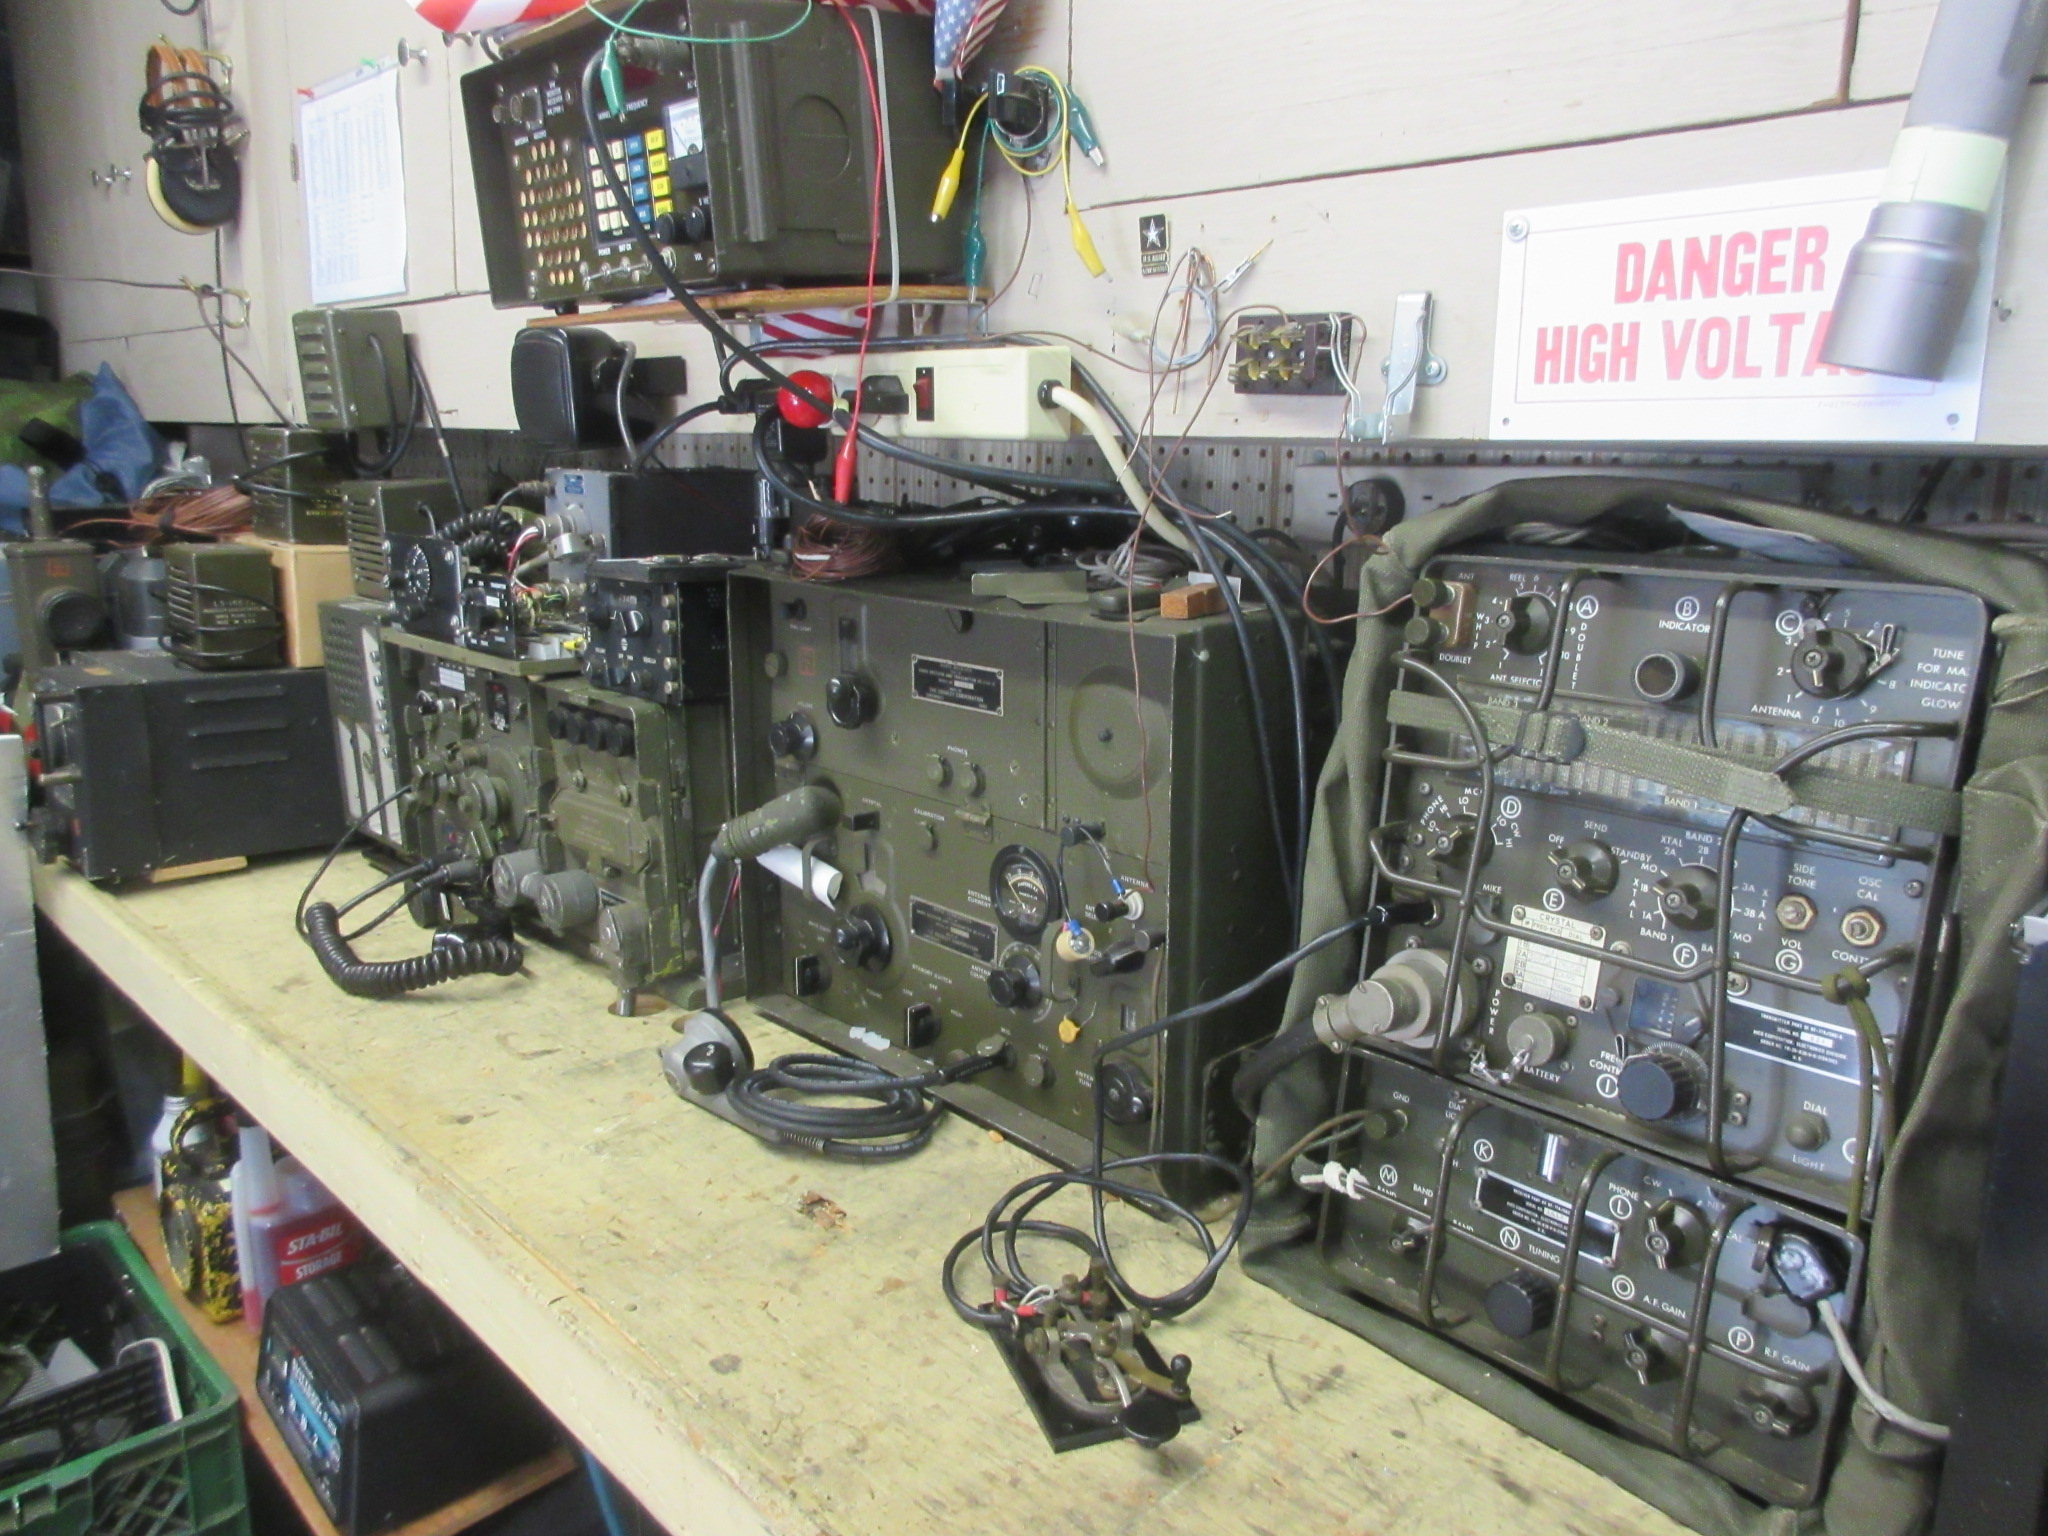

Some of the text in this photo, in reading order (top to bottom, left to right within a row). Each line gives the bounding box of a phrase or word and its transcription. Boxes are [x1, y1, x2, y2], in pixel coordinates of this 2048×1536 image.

[1614, 225, 1830, 304] DANGER
[1533, 311, 1865, 385] HIGH VOLTA
[1510, 574, 1526, 583] REEL
[1534, 575, 1539, 583] 6
[1474, 612, 1484, 650] WHIP
[1570, 627, 1575, 635] 9
[1659, 620, 1710, 633] INDICATOR
[1785, 637, 1791, 645] 3
[1439, 654, 1471, 664] DOUBLET
[1561, 651, 1570, 660] 10
[1571, 623, 1586, 689] DOUBLET
[1933, 648, 1964, 659] TUNE
[1777, 667, 1784, 676] 2
[1917, 663, 1969, 676] FOR MA
[1490, 674, 1543, 686] ANT SELECTO
[1889, 680, 1896, 689] 8
[1910, 679, 1967, 694] INDICATO
[1488, 697, 1507, 706] BAND
[1922, 698, 1962, 710] GLOW
[1751, 705, 1801, 719] ANTENNA
[1869, 706, 1877, 714] 9
[1603, 717, 1608, 726] 2
[1459, 797, 1469, 805] LO
[1664, 796, 1688, 808] BAND
[1421, 795, 1444, 825] PHONE
[1440, 805, 1448, 813] HI
[1428, 821, 1436, 832] LO
[1497, 815, 1506, 826] LO
[1584, 820, 1607, 832] SEND
[1511, 823, 1521, 838] CW
[1506, 839, 1513, 847] HI
[1549, 834, 1565, 845] OFF
[1661, 836, 1682, 847] XTAL
[1686, 831, 1712, 843] BAND
[1611, 846, 1652, 864] STANDBY
[1664, 848, 1676, 856] 2A
[1698, 846, 1708, 854] 2B
[1641, 863, 1657, 872] MO
[1793, 863, 1816, 876] SIDE
[1121, 875, 1149, 888] ANTENNA
[1788, 875, 1817, 890] TONE
[1858, 877, 1882, 889] OSC
[1483, 884, 1502, 893] MIKE
[1742, 883, 1755, 893] 3A
[1629, 878, 1639, 918] XTAL
[1857, 889, 1879, 902] CAL
[1643, 912, 1652, 921] 1A
[1744, 908, 1756, 918] 3B
[1758, 890, 1768, 931] XTAL
[1539, 913, 1576, 929] CRYSTAL
[1569, 931, 1583, 940] DIAL
[1640, 928, 1667, 941] BAND
[1733, 933, 1751, 942] MO
[1701, 944, 1714, 953] BA
[1781, 937, 1803, 951] VOL
[1516, 960, 1525, 968] 2B
[1489, 989, 1501, 1035] POWER
[1524, 1066, 1561, 1083] BATTERY
[1393, 1092, 1410, 1103] GND
[1803, 1101, 1828, 1116] DIAL
[1792, 1154, 1826, 1172] LIGHT
[1643, 1176, 1662, 1187] CW
[1413, 1184, 1434, 1196] BAND
[1609, 1182, 1639, 1201] PHONE
[287, 1222, 343, 1255] STA-BIL
[1528, 1244, 1560, 1264] TUNING
[296, 1251, 343, 1280] STORAGE
[1661, 1302, 1686, 1319] GAIN
[1782, 1355, 1810, 1372] GAIN
